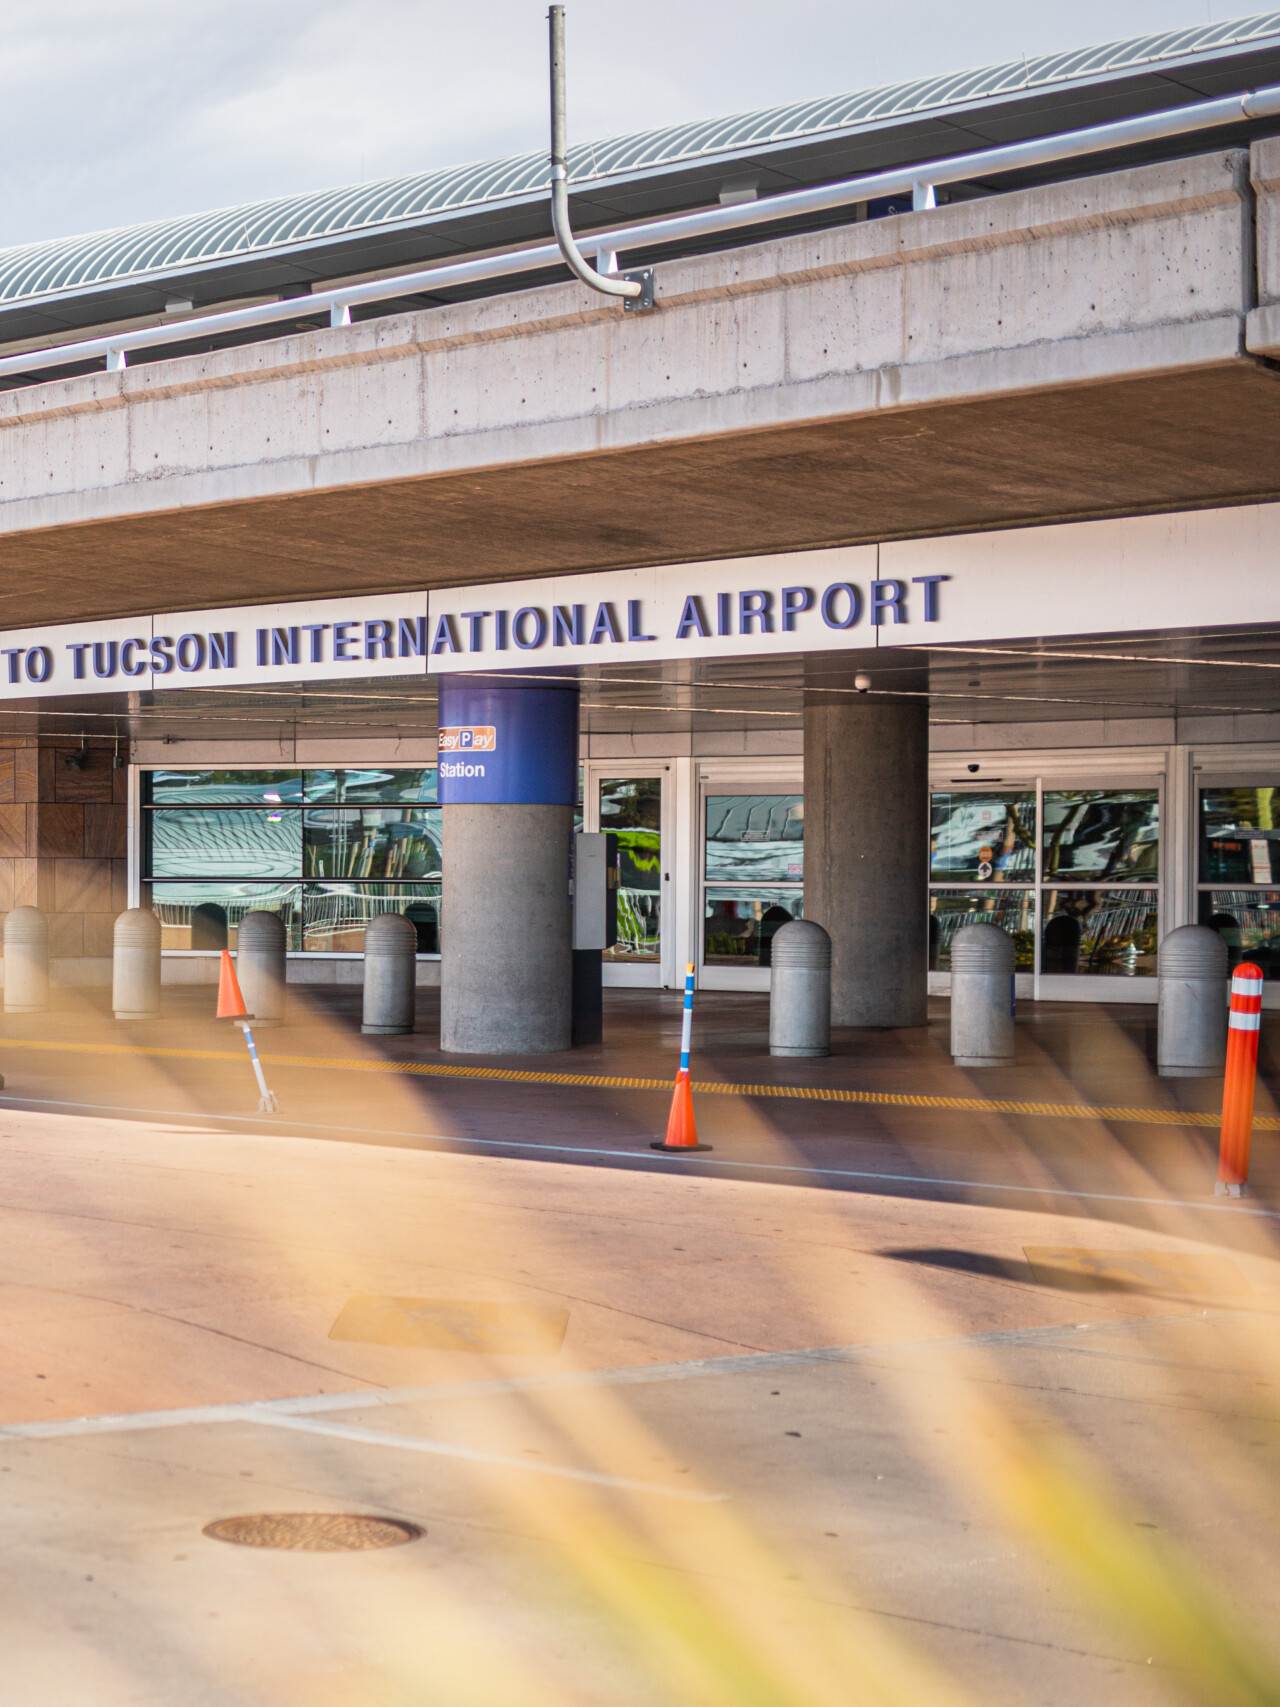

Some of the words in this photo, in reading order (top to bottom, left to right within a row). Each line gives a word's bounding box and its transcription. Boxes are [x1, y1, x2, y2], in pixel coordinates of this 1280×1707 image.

[1, 646, 55, 683] TO
[66, 631, 238, 680] TUCSON
[256, 600, 657, 667] INTERNATIONAL
[676, 574, 952, 640] AIRPORT
[440, 762, 485, 777] Station
